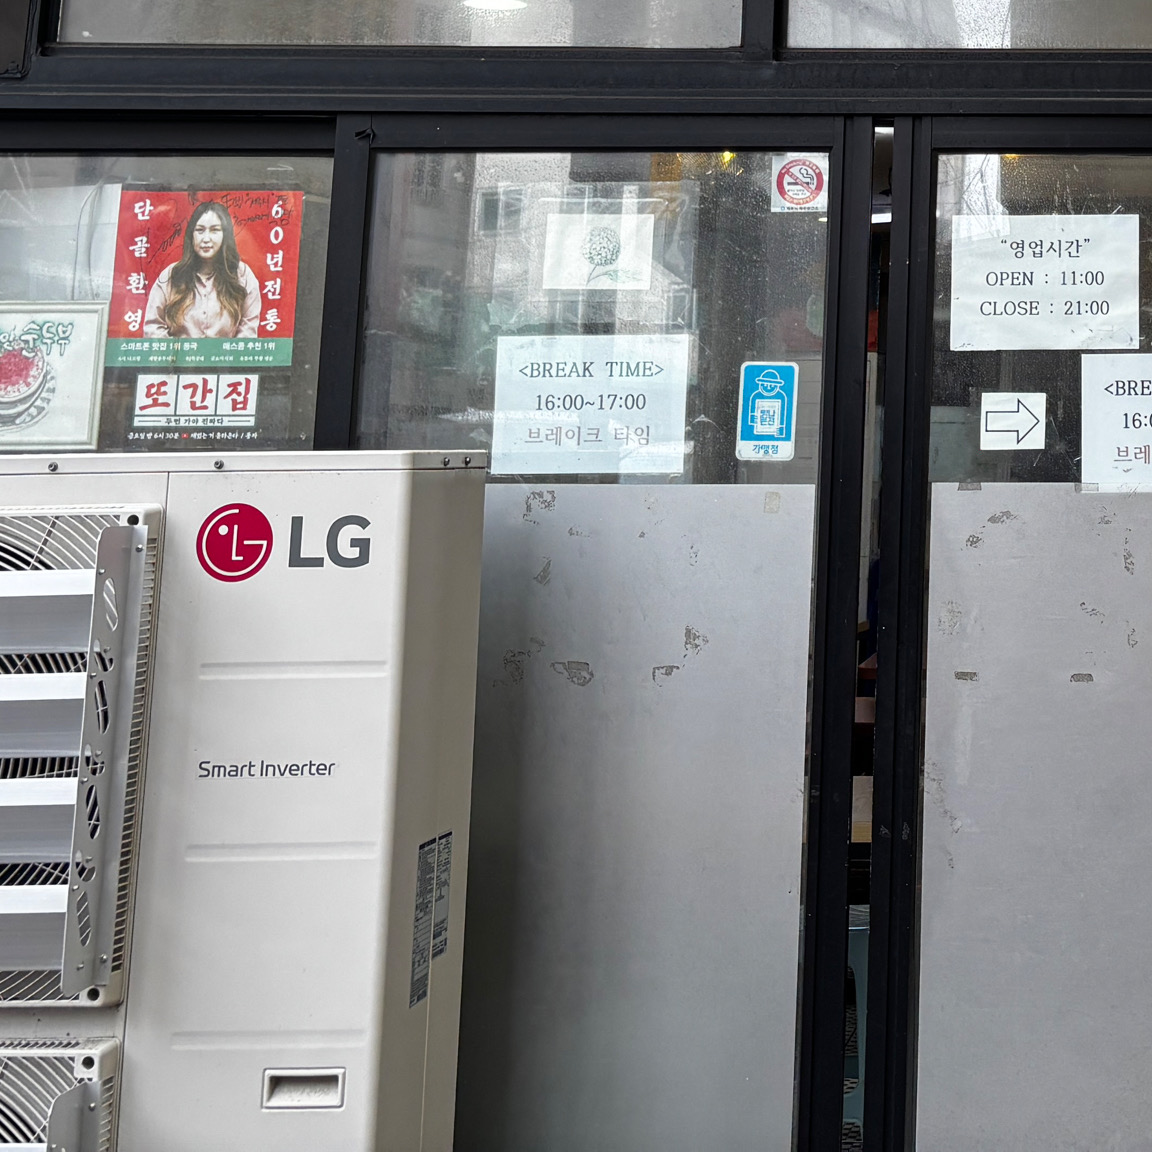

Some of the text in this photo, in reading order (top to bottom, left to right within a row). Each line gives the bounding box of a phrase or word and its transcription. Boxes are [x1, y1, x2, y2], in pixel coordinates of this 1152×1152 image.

[124, 199, 154, 331] 단골환영
[260, 201, 285, 331] 60년전통
[986, 271, 1034, 286] OPEN
[1061, 270, 1105, 286] 11:00
[980, 300, 1040, 316] CLOSE
[1064, 300, 1110, 315] 21:00
[519, 360, 665, 378] <BREAK TIME>
[138, 377, 252, 412] 또간집
[535, 393, 647, 411] 16:00~17:00
[525, 425, 651, 447] 브레이크 타임
[288, 514, 372, 569] LG
[198, 759, 336, 778] Smart Inverter
